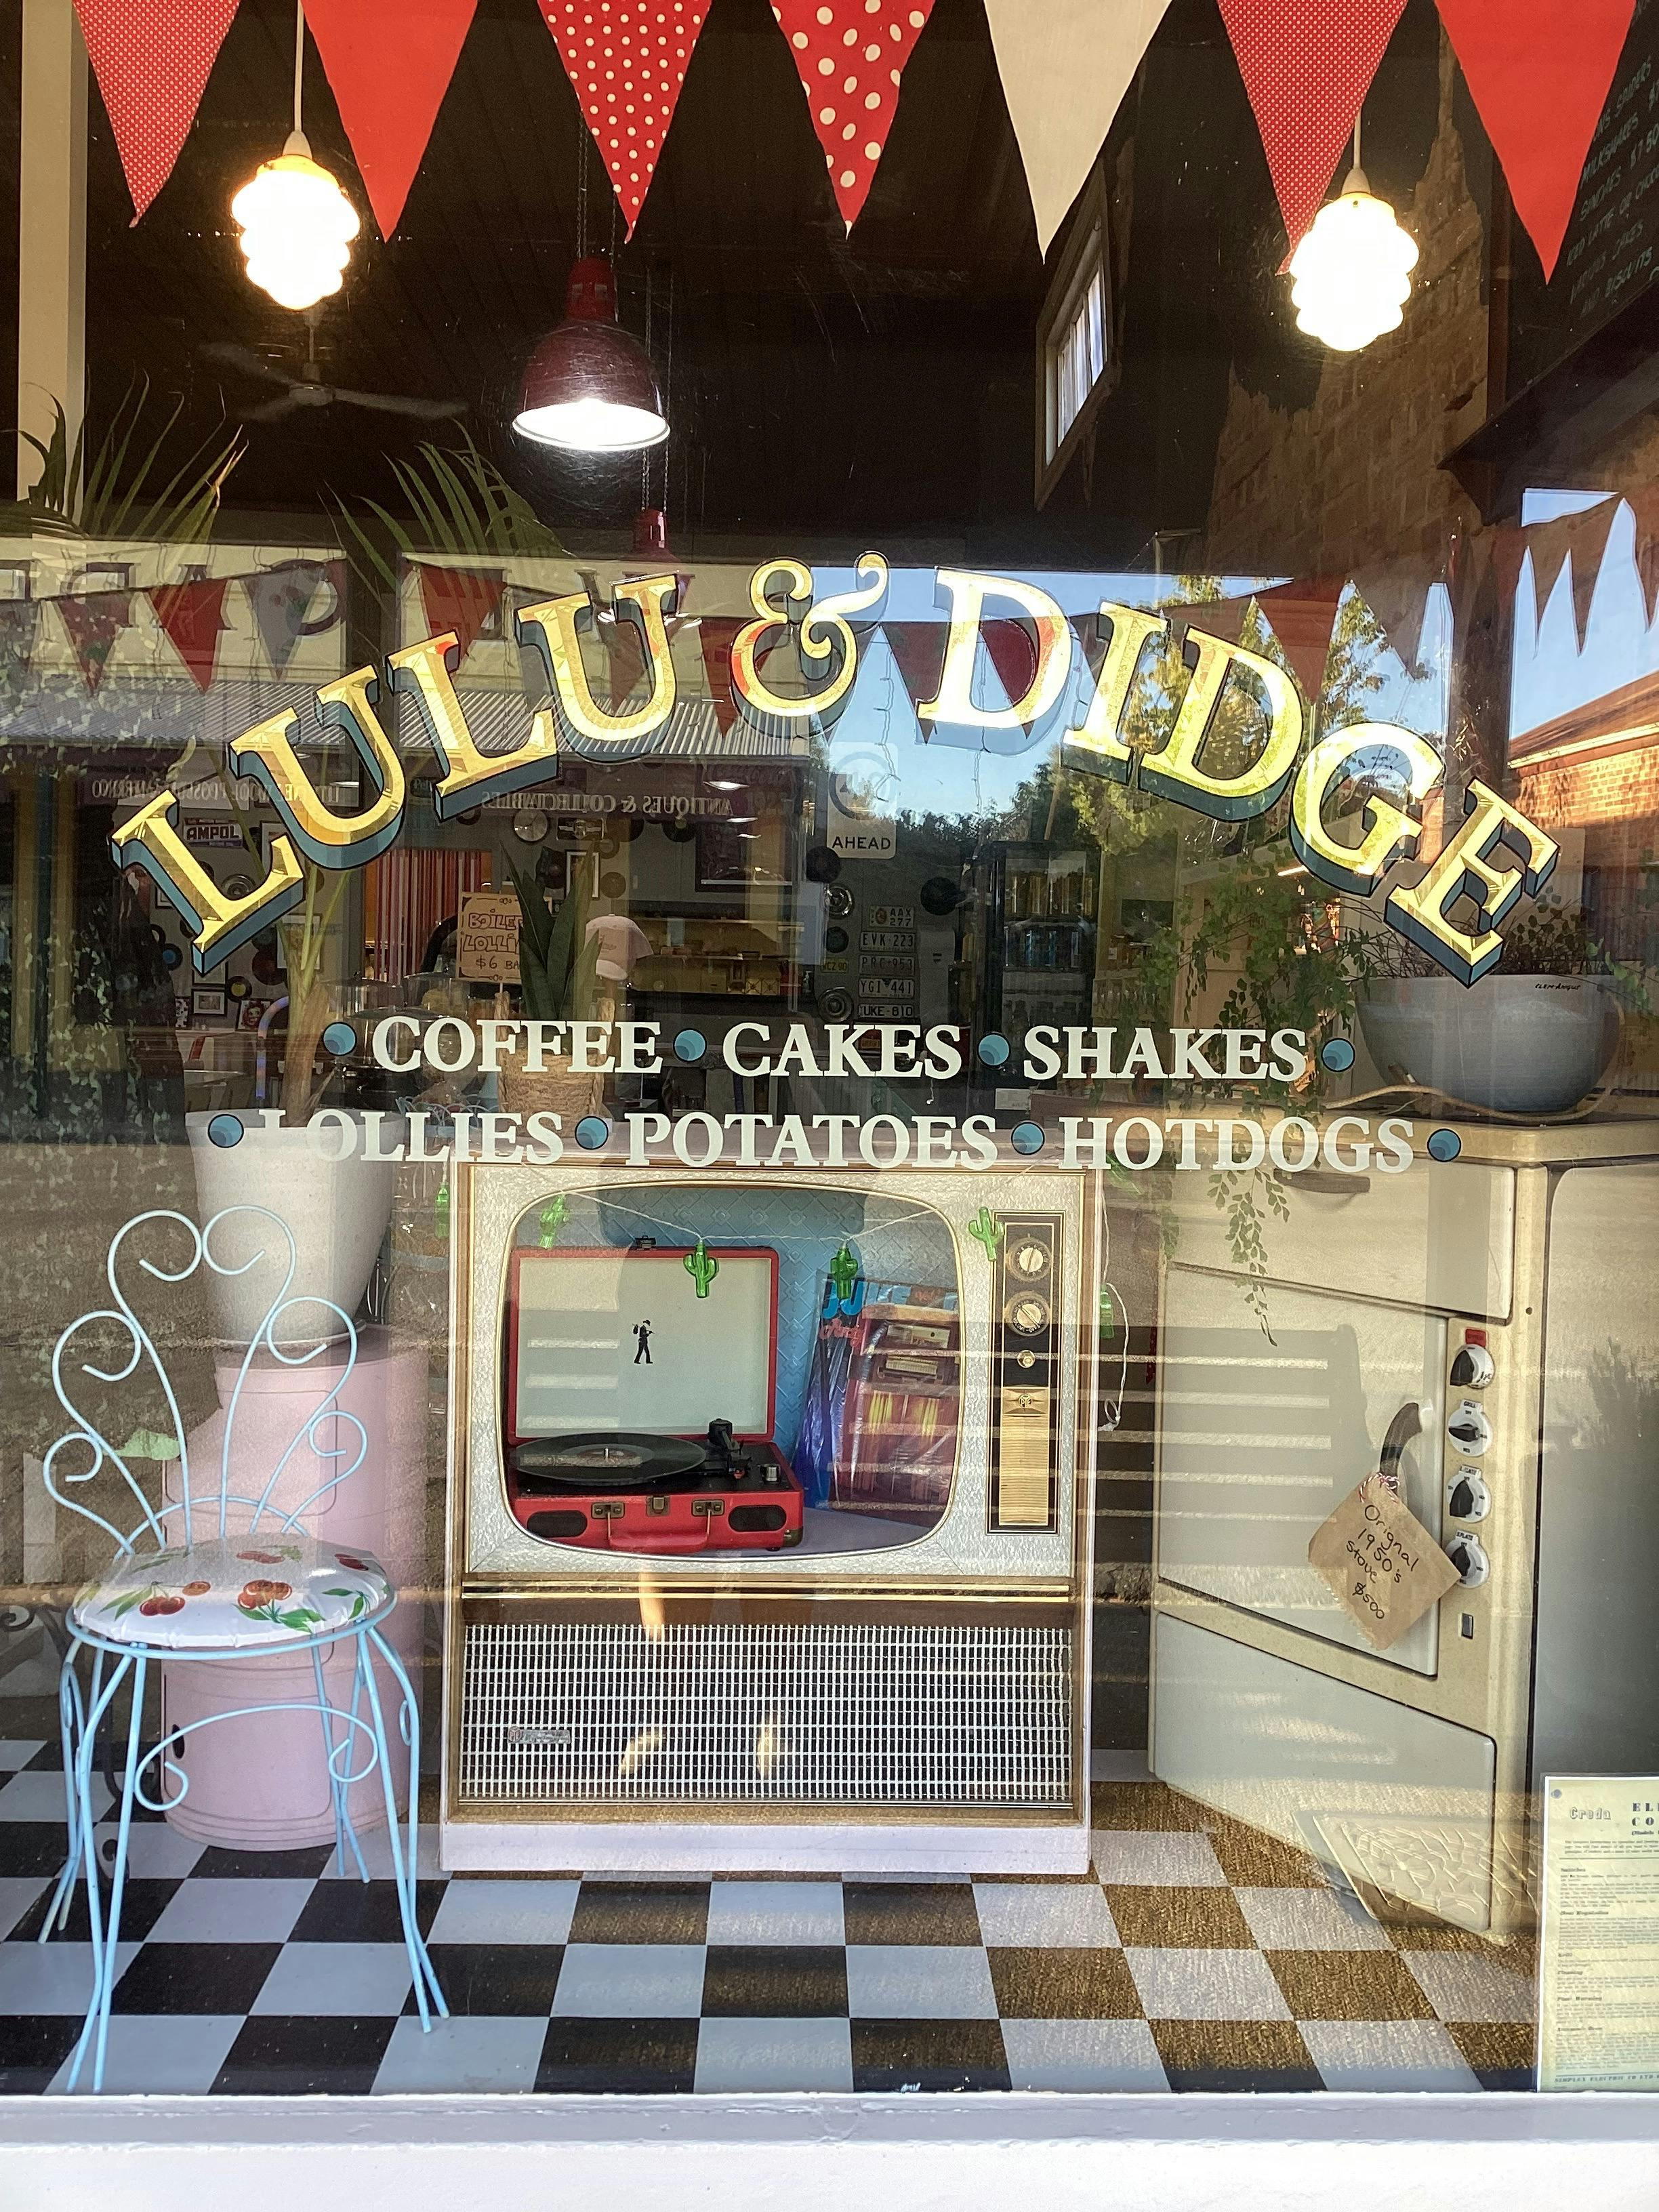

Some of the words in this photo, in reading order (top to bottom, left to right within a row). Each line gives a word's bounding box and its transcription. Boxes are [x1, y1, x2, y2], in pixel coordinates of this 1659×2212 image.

[110, 572, 678, 976] LULU
[729, 550, 890, 737] &
[916, 567, 1560, 989] DIDGE
[186, 825, 239, 840] AMPOL
[832, 836, 891, 850] AHEAD
[890, 908, 912, 917] AAX
[890, 918, 912, 926] 277
[463, 933, 520, 955] LOLLI
[476, 954, 497, 969] $6
[504, 960, 520, 970] BA
[372, 1015, 663, 1074] COFFEE
[722, 1022, 962, 1080] CAKES
[1023, 1025, 1307, 1082] SHAKES
[258, 1108, 564, 1166] LOLLIES
[625, 1111, 998, 1170] POTATOES
[1058, 1115, 1414, 1174] HOTDOGS
[1365, 1504, 1419, 1572] Orignal
[1358, 1528, 1401, 1583] 1950's
[1352, 1582, 1385, 1619] $500
[1570, 1806, 1612, 1820] Creda
